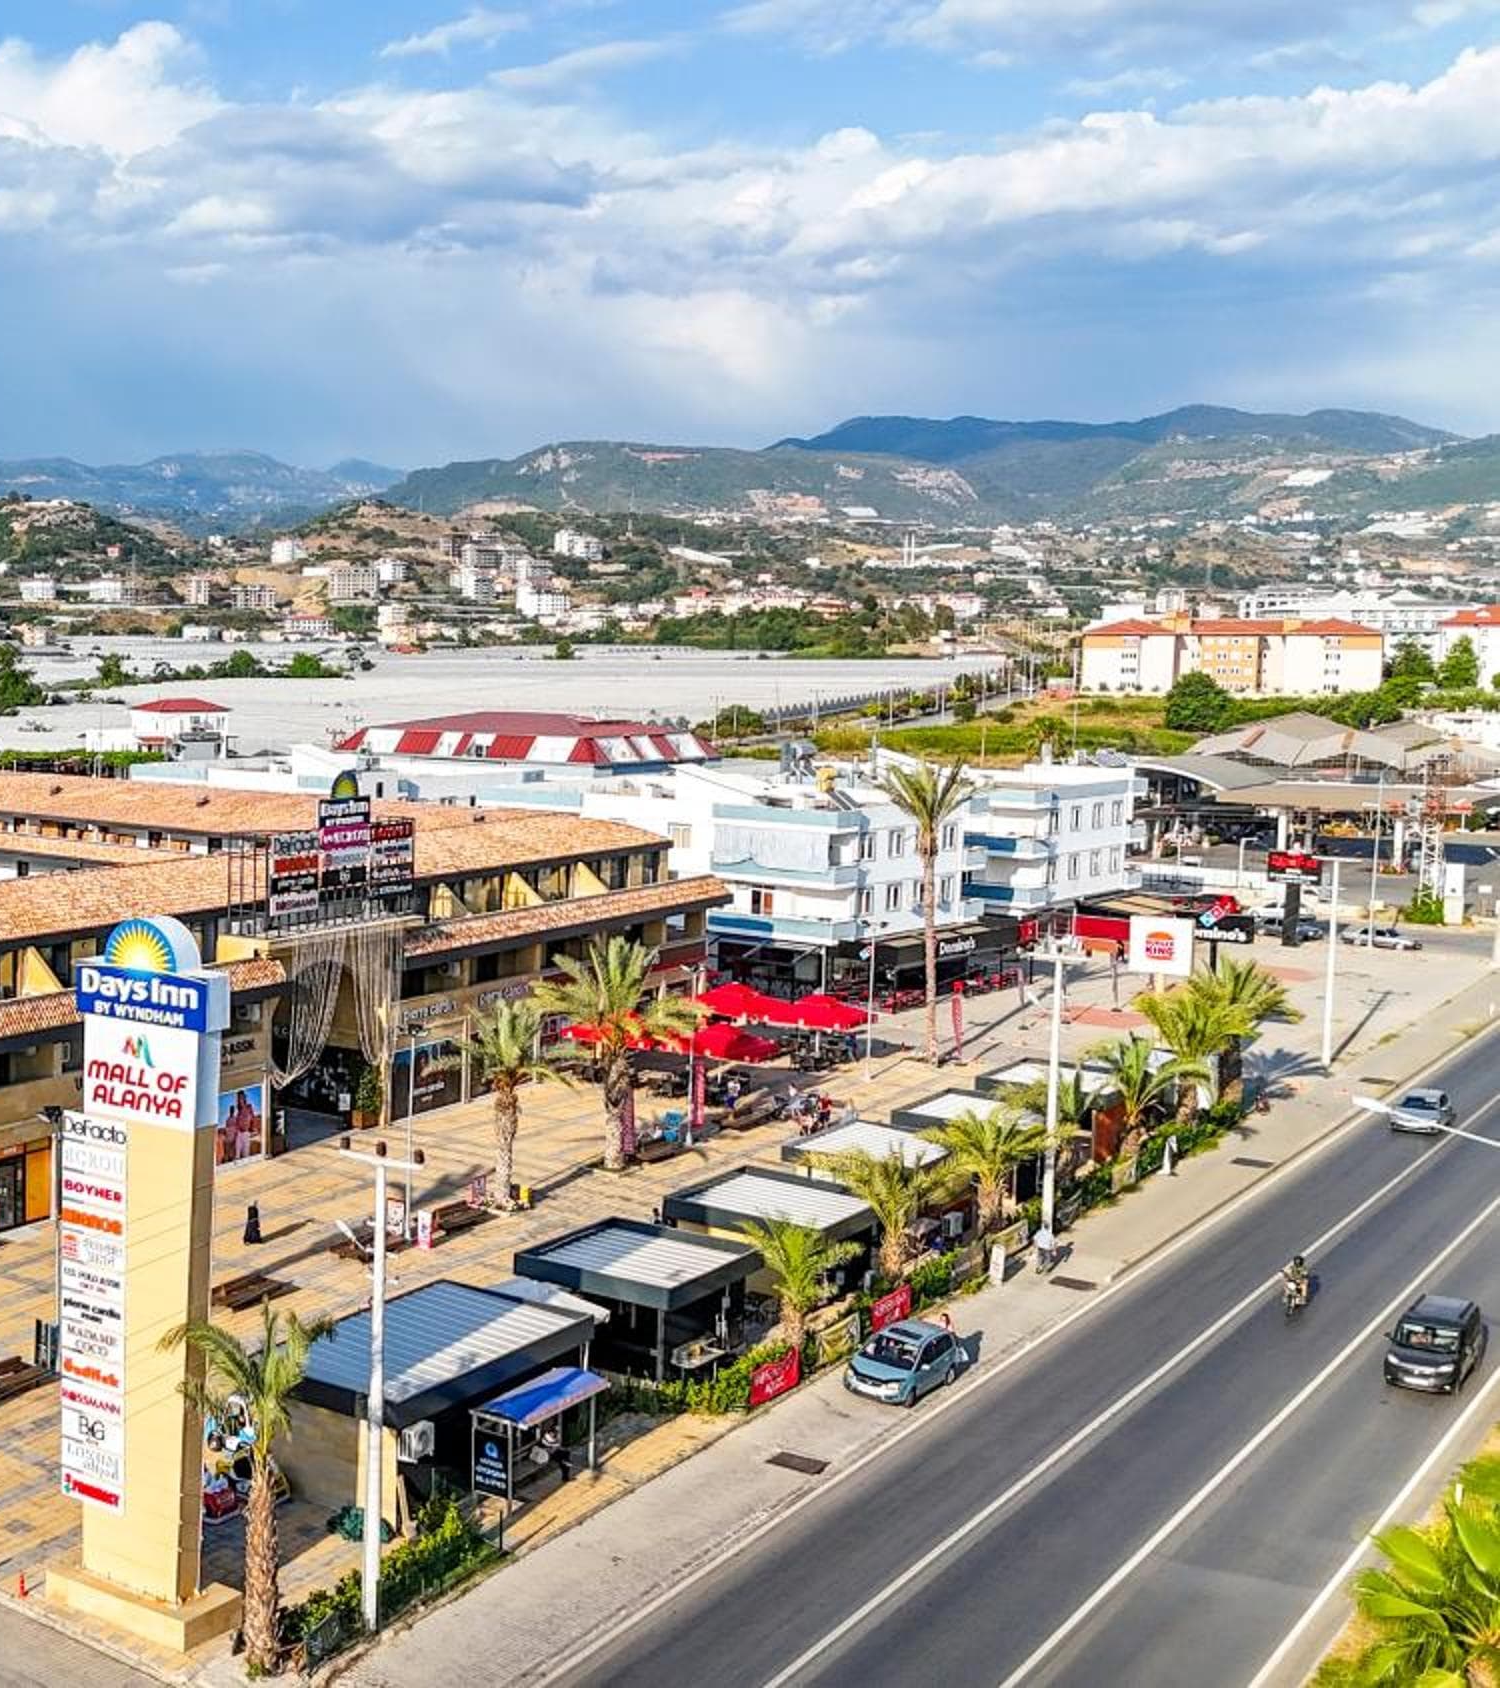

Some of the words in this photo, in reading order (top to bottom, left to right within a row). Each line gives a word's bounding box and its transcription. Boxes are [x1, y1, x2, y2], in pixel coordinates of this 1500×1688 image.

[1145, 946, 1174, 956] KING
[93, 1000, 113, 1015] BY
[114, 1003, 185, 1027] WYNDHAM
[87, 1060, 149, 1089] MALL
[157, 1072, 189, 1094] OF
[92, 1084, 182, 1119] ALANYA
[64, 1115, 127, 1145] DeFacto
[61, 1387, 121, 1416] ROSSMANN
